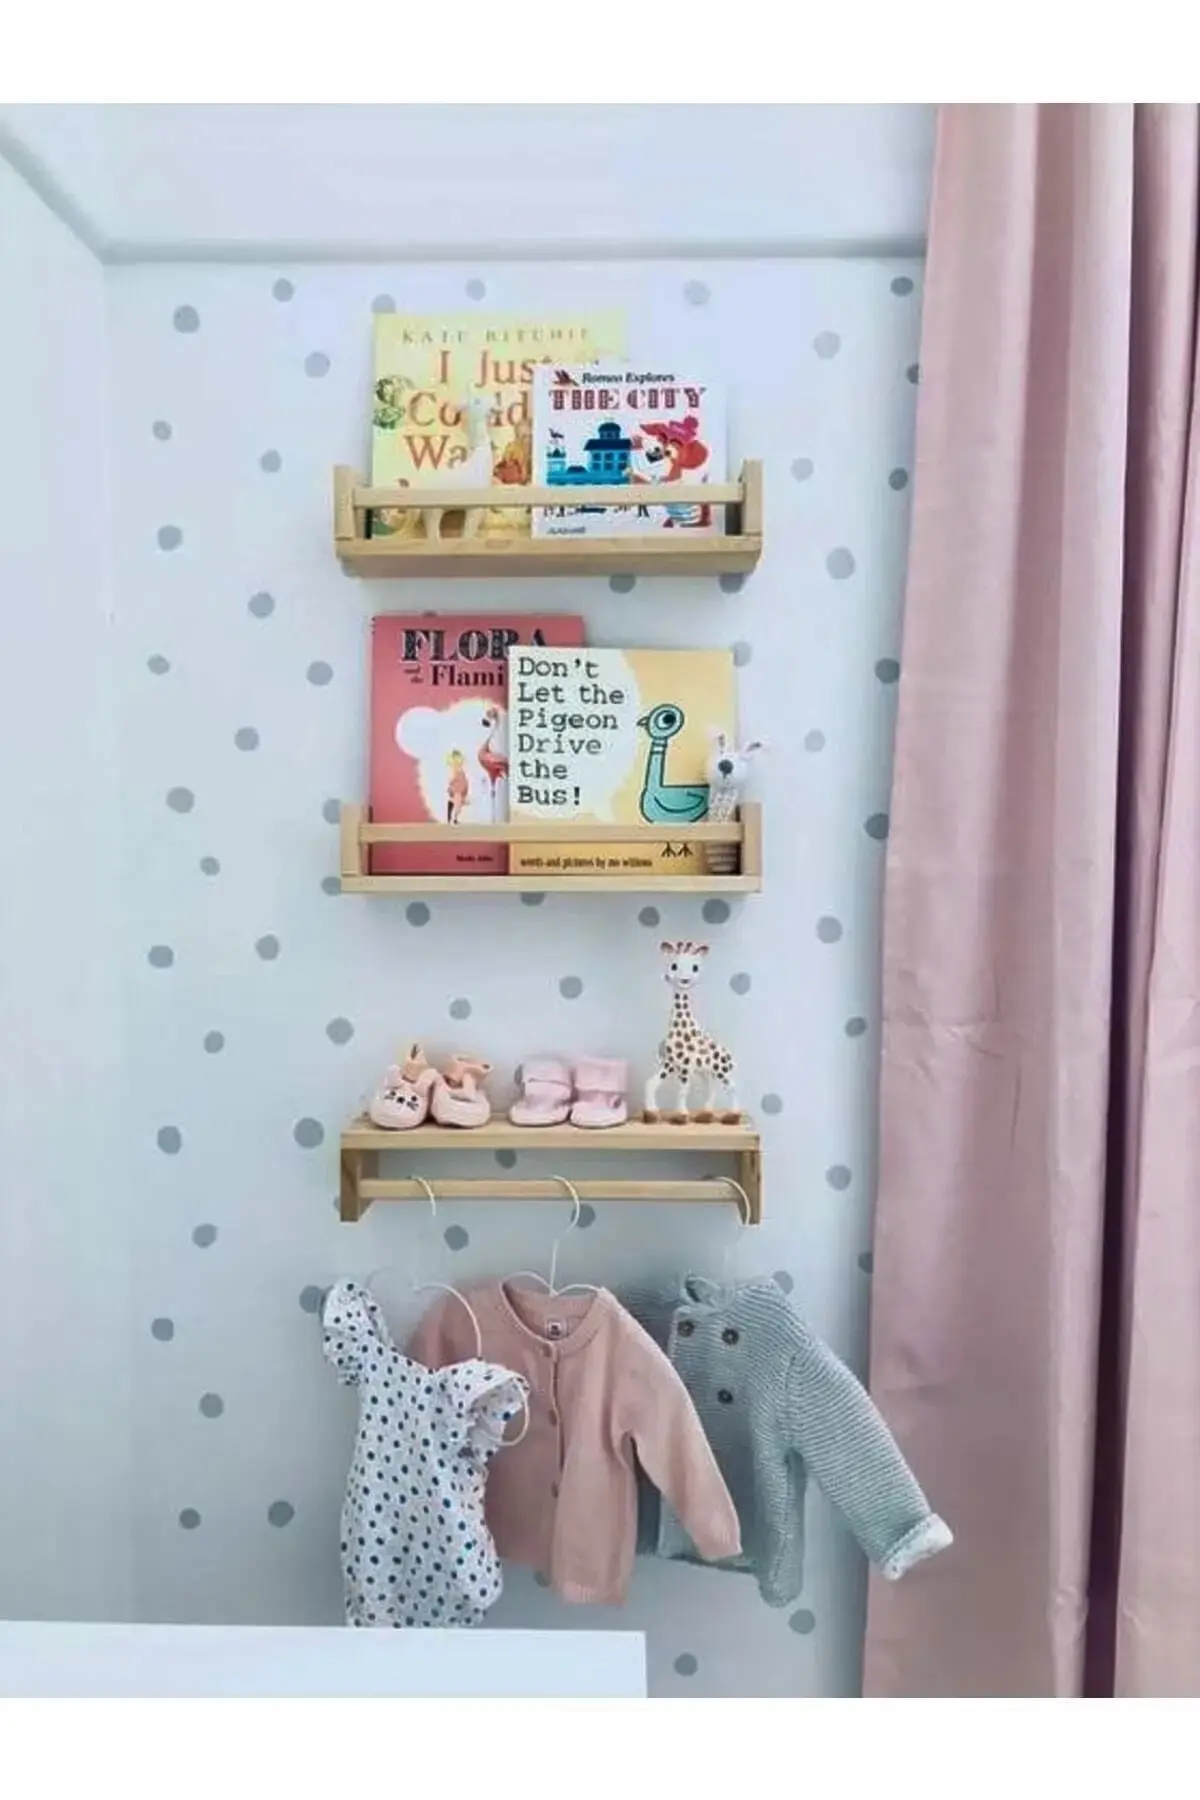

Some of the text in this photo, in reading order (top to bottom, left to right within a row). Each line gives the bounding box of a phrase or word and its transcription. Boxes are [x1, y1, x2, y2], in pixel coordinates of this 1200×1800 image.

[440, 350, 450, 384] I
[549, 387, 706, 410] THE CITY
[431, 664, 504, 686] Flami
[518, 656, 600, 679] Don't
[517, 682, 625, 705] Let the
[518, 707, 618, 732] Pigeon
[517, 733, 602, 755] Drive
[519, 759, 569, 780] the
[517, 785, 581, 806] Bus!
